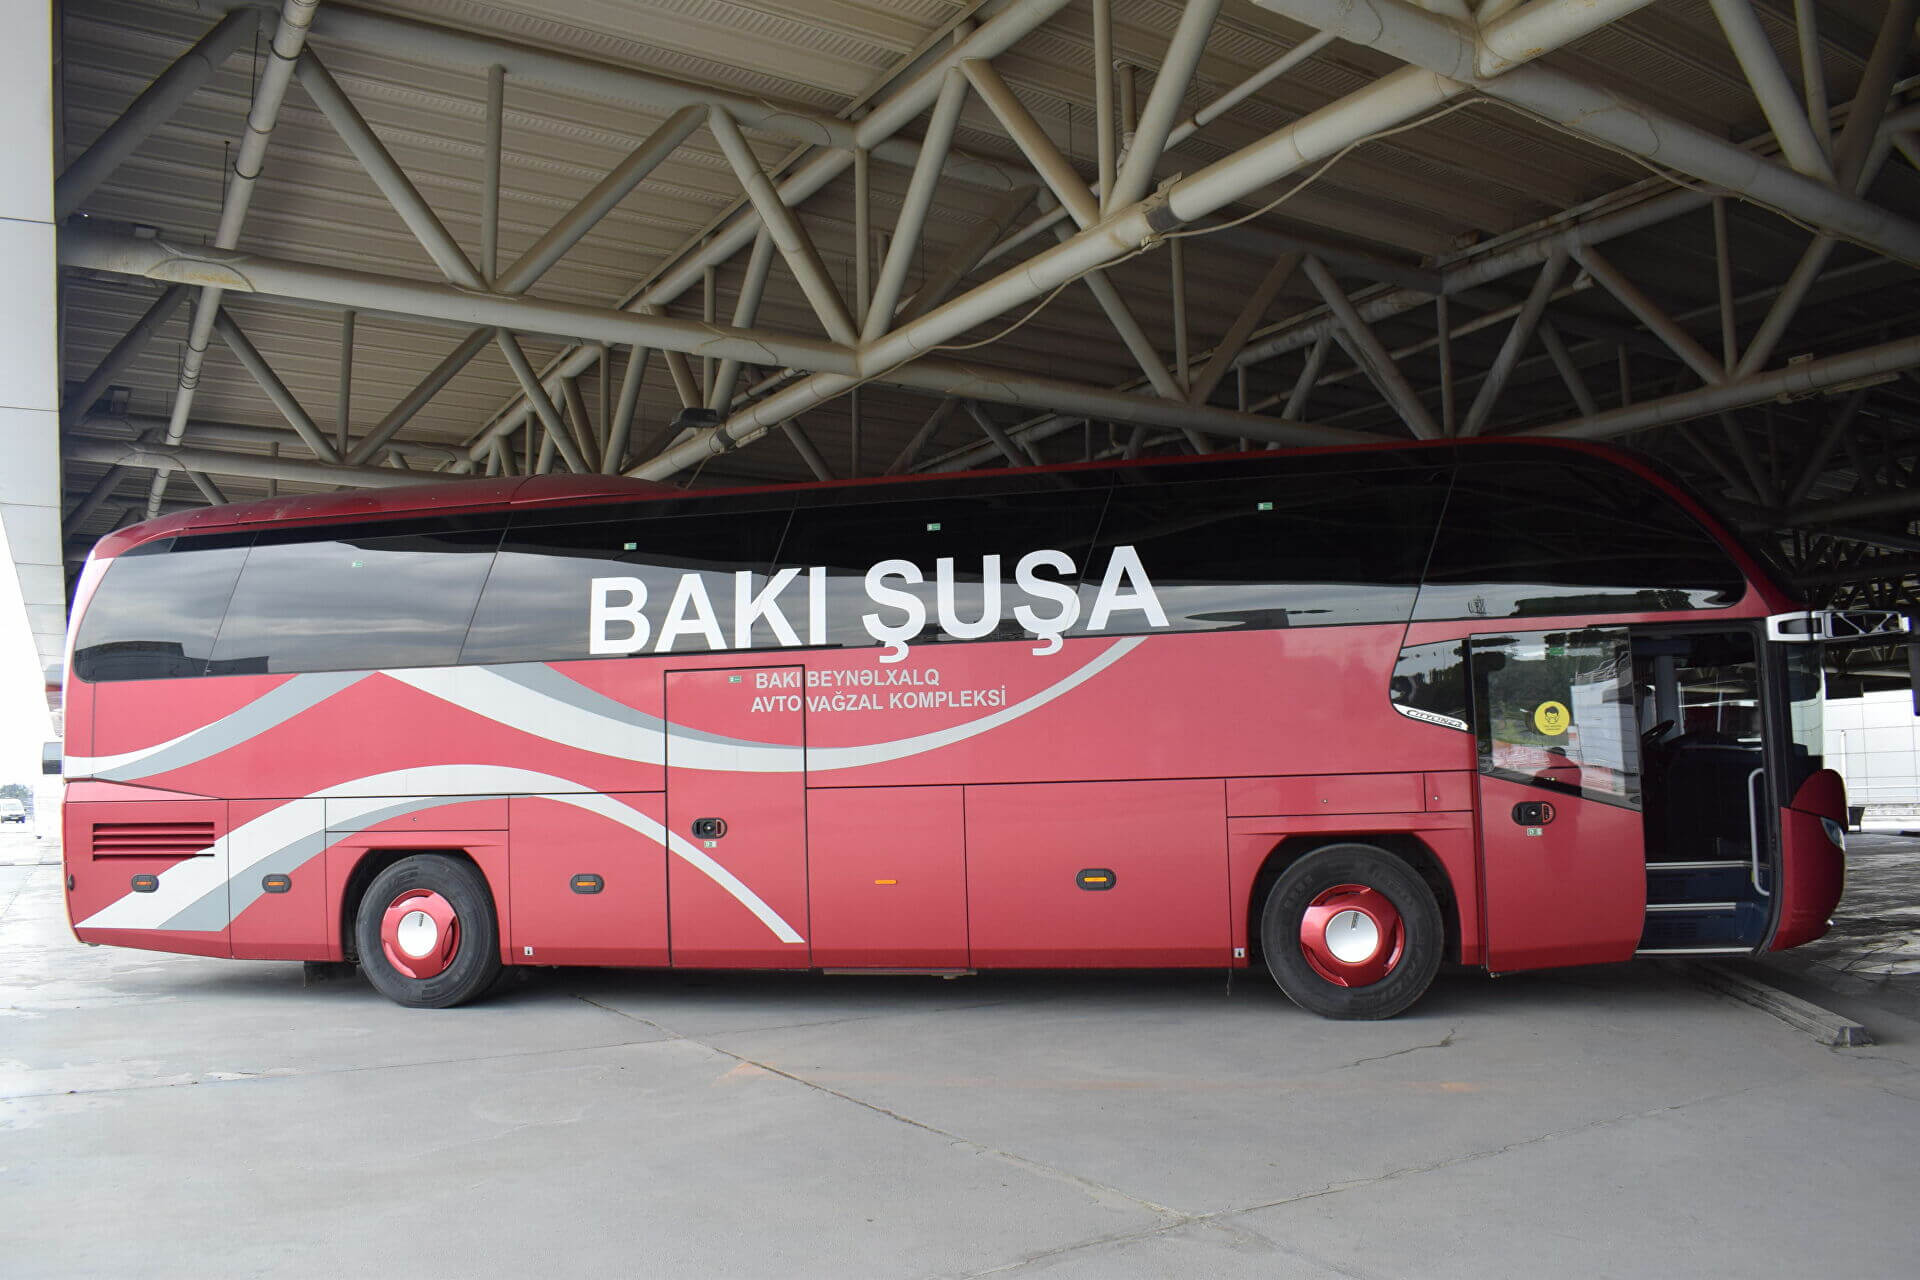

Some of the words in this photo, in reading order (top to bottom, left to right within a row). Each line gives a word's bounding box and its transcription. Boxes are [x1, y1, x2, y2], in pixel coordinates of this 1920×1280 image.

[589, 567, 828, 655] BAKI
[862, 546, 1169, 663] ŞUŞA
[755, 671, 801, 688] BAKI
[807, 669, 940, 687] BEYNƏLXALQ
[751, 695, 801, 712] AVTO
[807, 690, 883, 712] VAĞZAL
[890, 684, 1006, 709] KOMPLEKSİ
